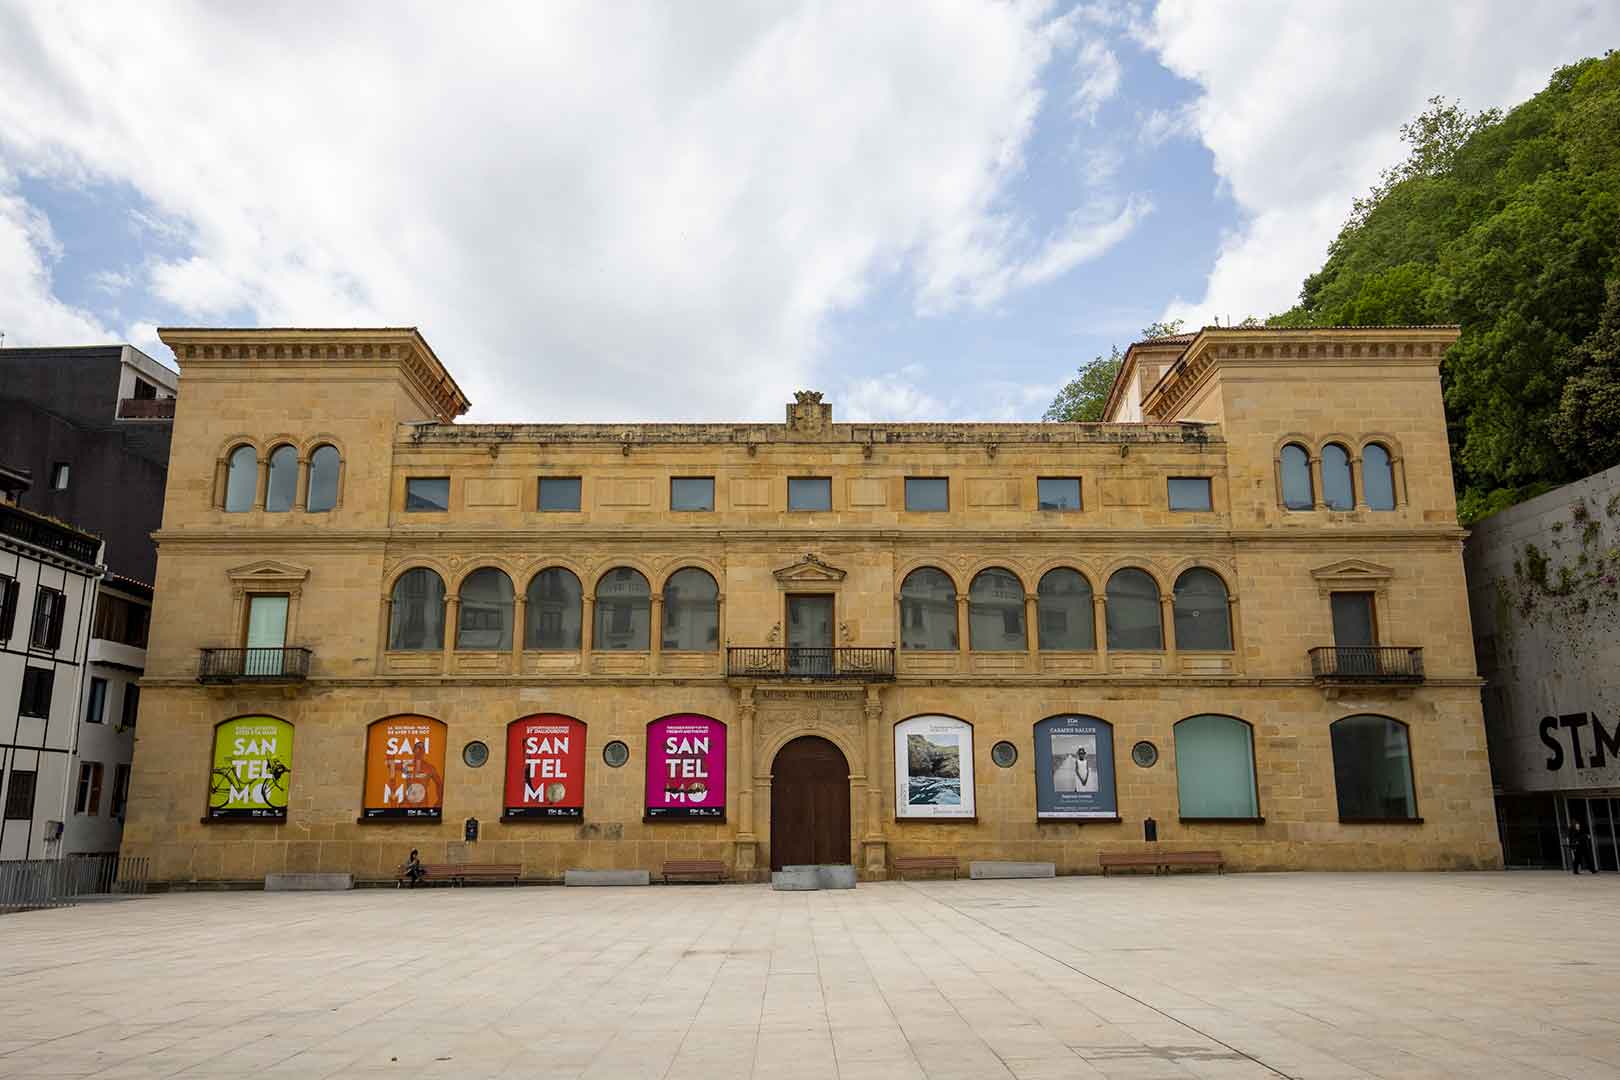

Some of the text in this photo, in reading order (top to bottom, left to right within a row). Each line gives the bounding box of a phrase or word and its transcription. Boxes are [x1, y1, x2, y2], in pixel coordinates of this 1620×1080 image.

[233, 738, 276, 755] SAN
[526, 737, 569, 754] SAN
[666, 737, 709, 754] SAN
[232, 760, 273, 779] TEL
[525, 759, 568, 778] TEL
[665, 759, 708, 778] TEL
[384, 783, 426, 803] MO
[524, 783, 566, 803] MO
[664, 783, 708, 803] MO
